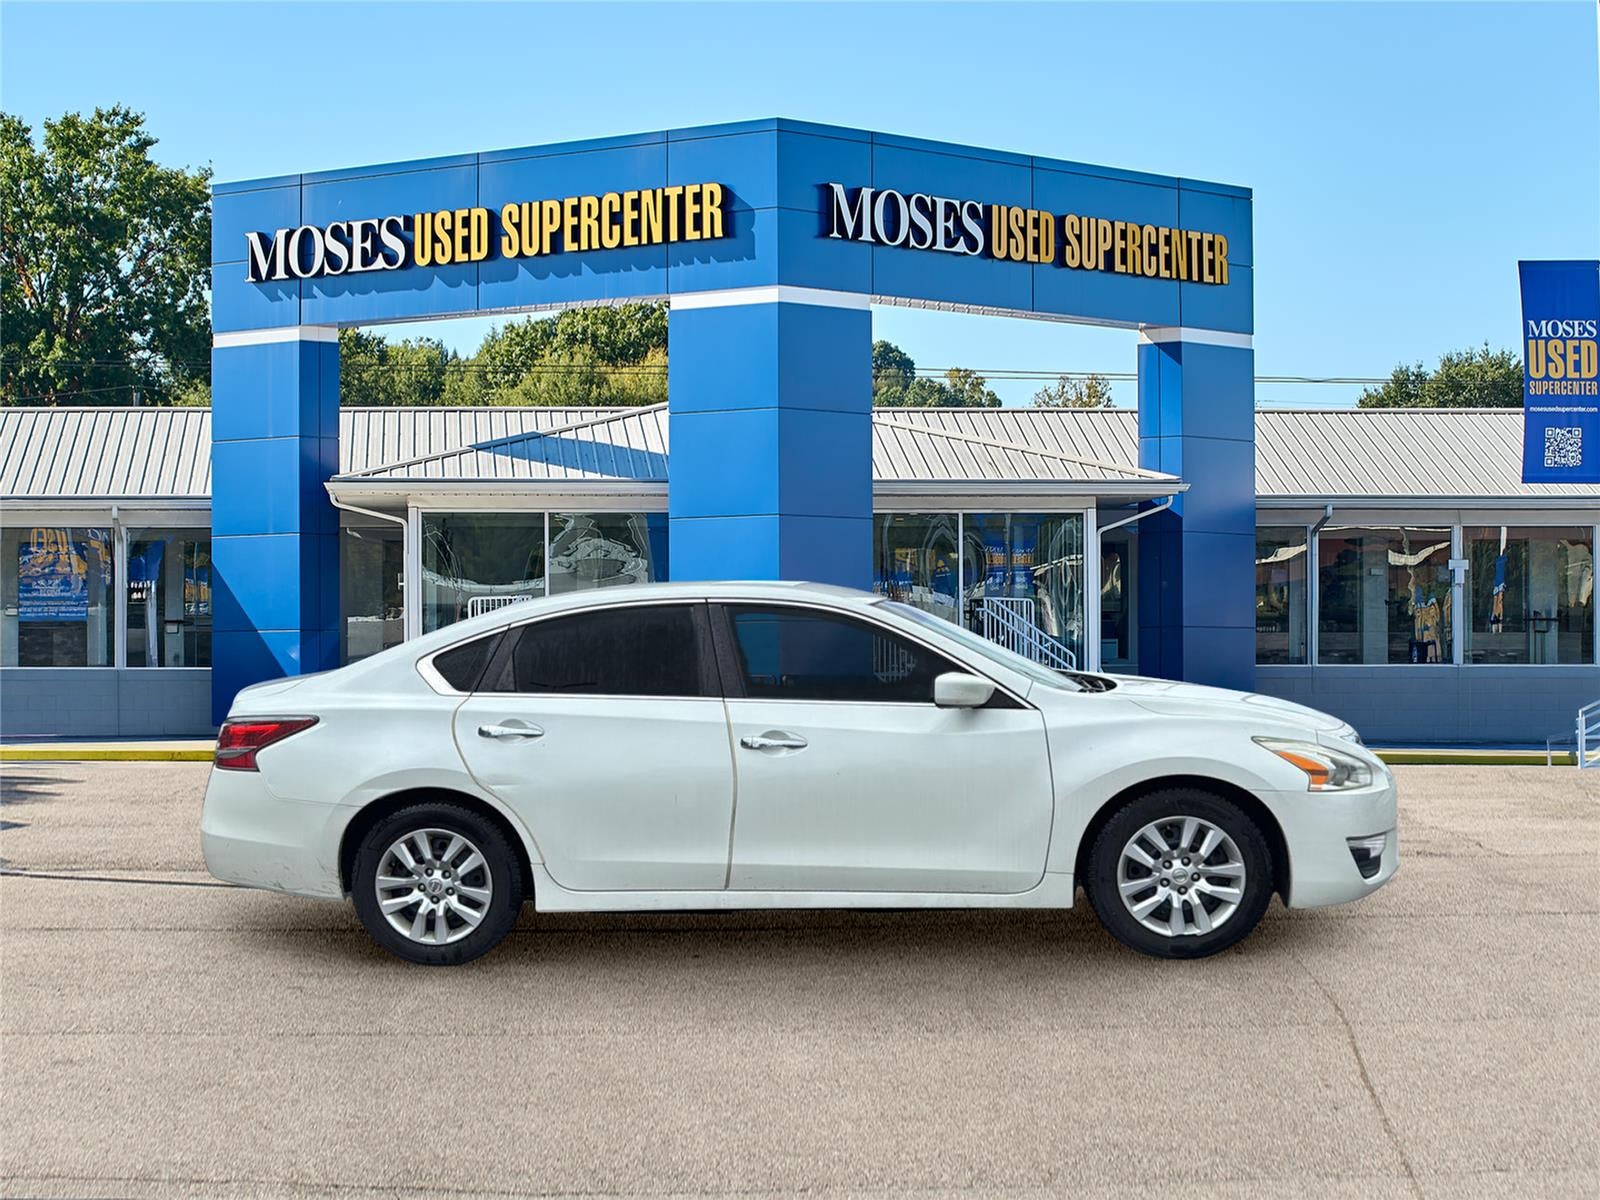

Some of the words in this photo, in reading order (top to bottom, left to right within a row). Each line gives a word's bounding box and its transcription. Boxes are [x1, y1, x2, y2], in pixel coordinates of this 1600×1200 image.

[244, 215, 408, 283] MOSES
[413, 207, 489, 267] USED
[500, 183, 724, 259] SUPERCENTER
[829, 182, 985, 256] MOSES
[991, 204, 1056, 265] USED
[1065, 214, 1230, 285] SUPERCENTER
[1528, 320, 1597, 338] MOSES
[1528, 340, 1598, 379] USED
[1529, 382, 1598, 395] SUPERCENTER
